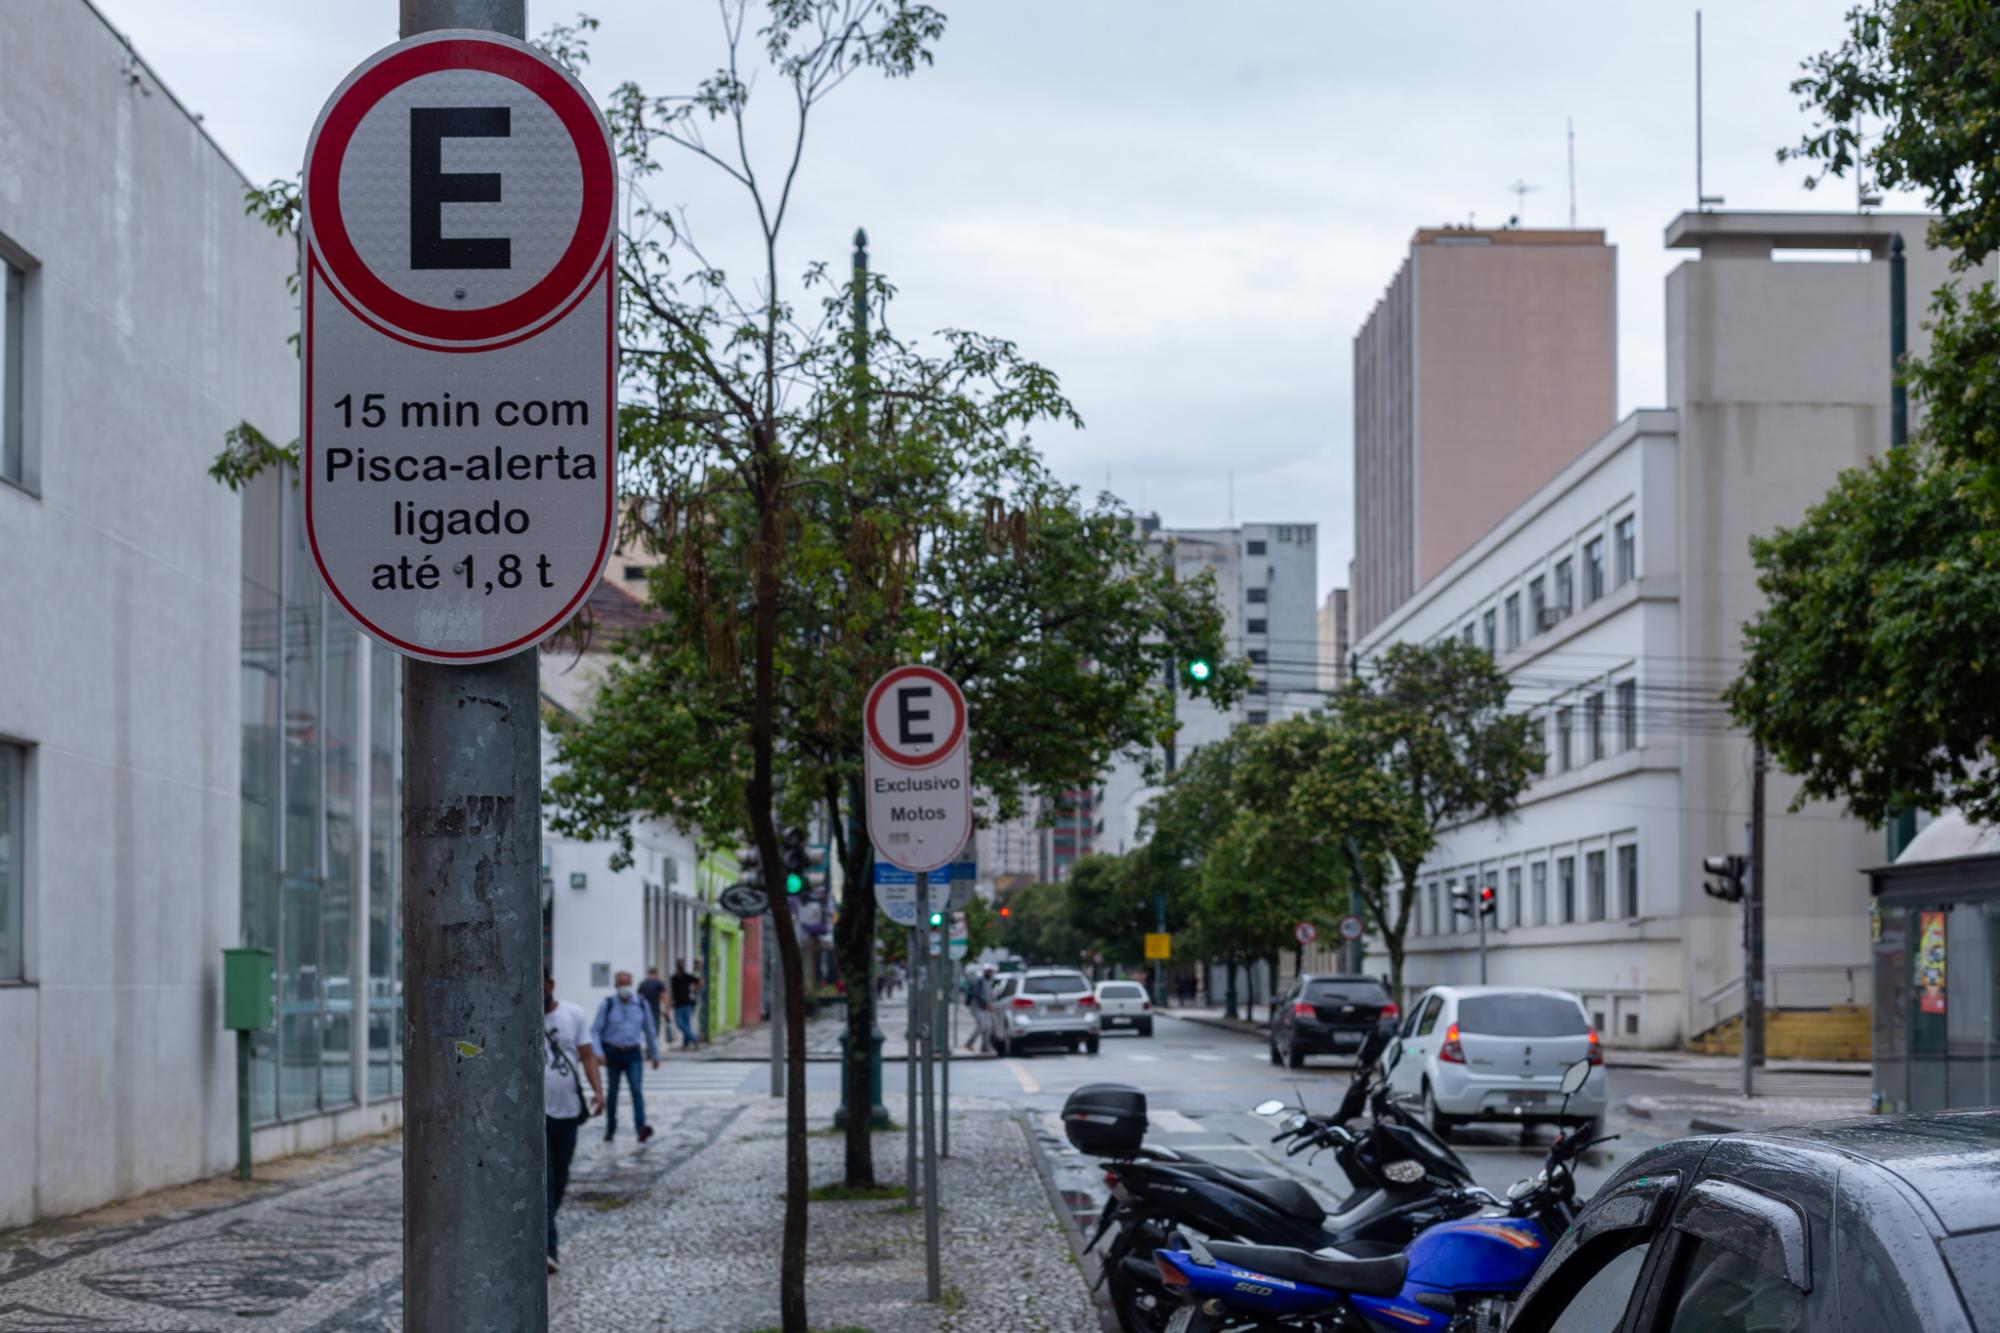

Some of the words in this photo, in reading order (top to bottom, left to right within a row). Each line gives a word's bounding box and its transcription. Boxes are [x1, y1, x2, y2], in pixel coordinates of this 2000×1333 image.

[410, 106, 511, 270] E
[333, 392, 387, 429] 15
[400, 392, 480, 428] min
[494, 400, 589, 427] com
[325, 446, 598, 483] Pisca-alerta
[393, 500, 531, 546] ligado
[371, 554, 441, 591] até
[459, 553, 523, 597] 1,8
[536, 553, 555, 590] t
[897, 686, 934, 745] E
[874, 776, 961, 794] Exclusivo
[890, 805, 947, 822] Motos
